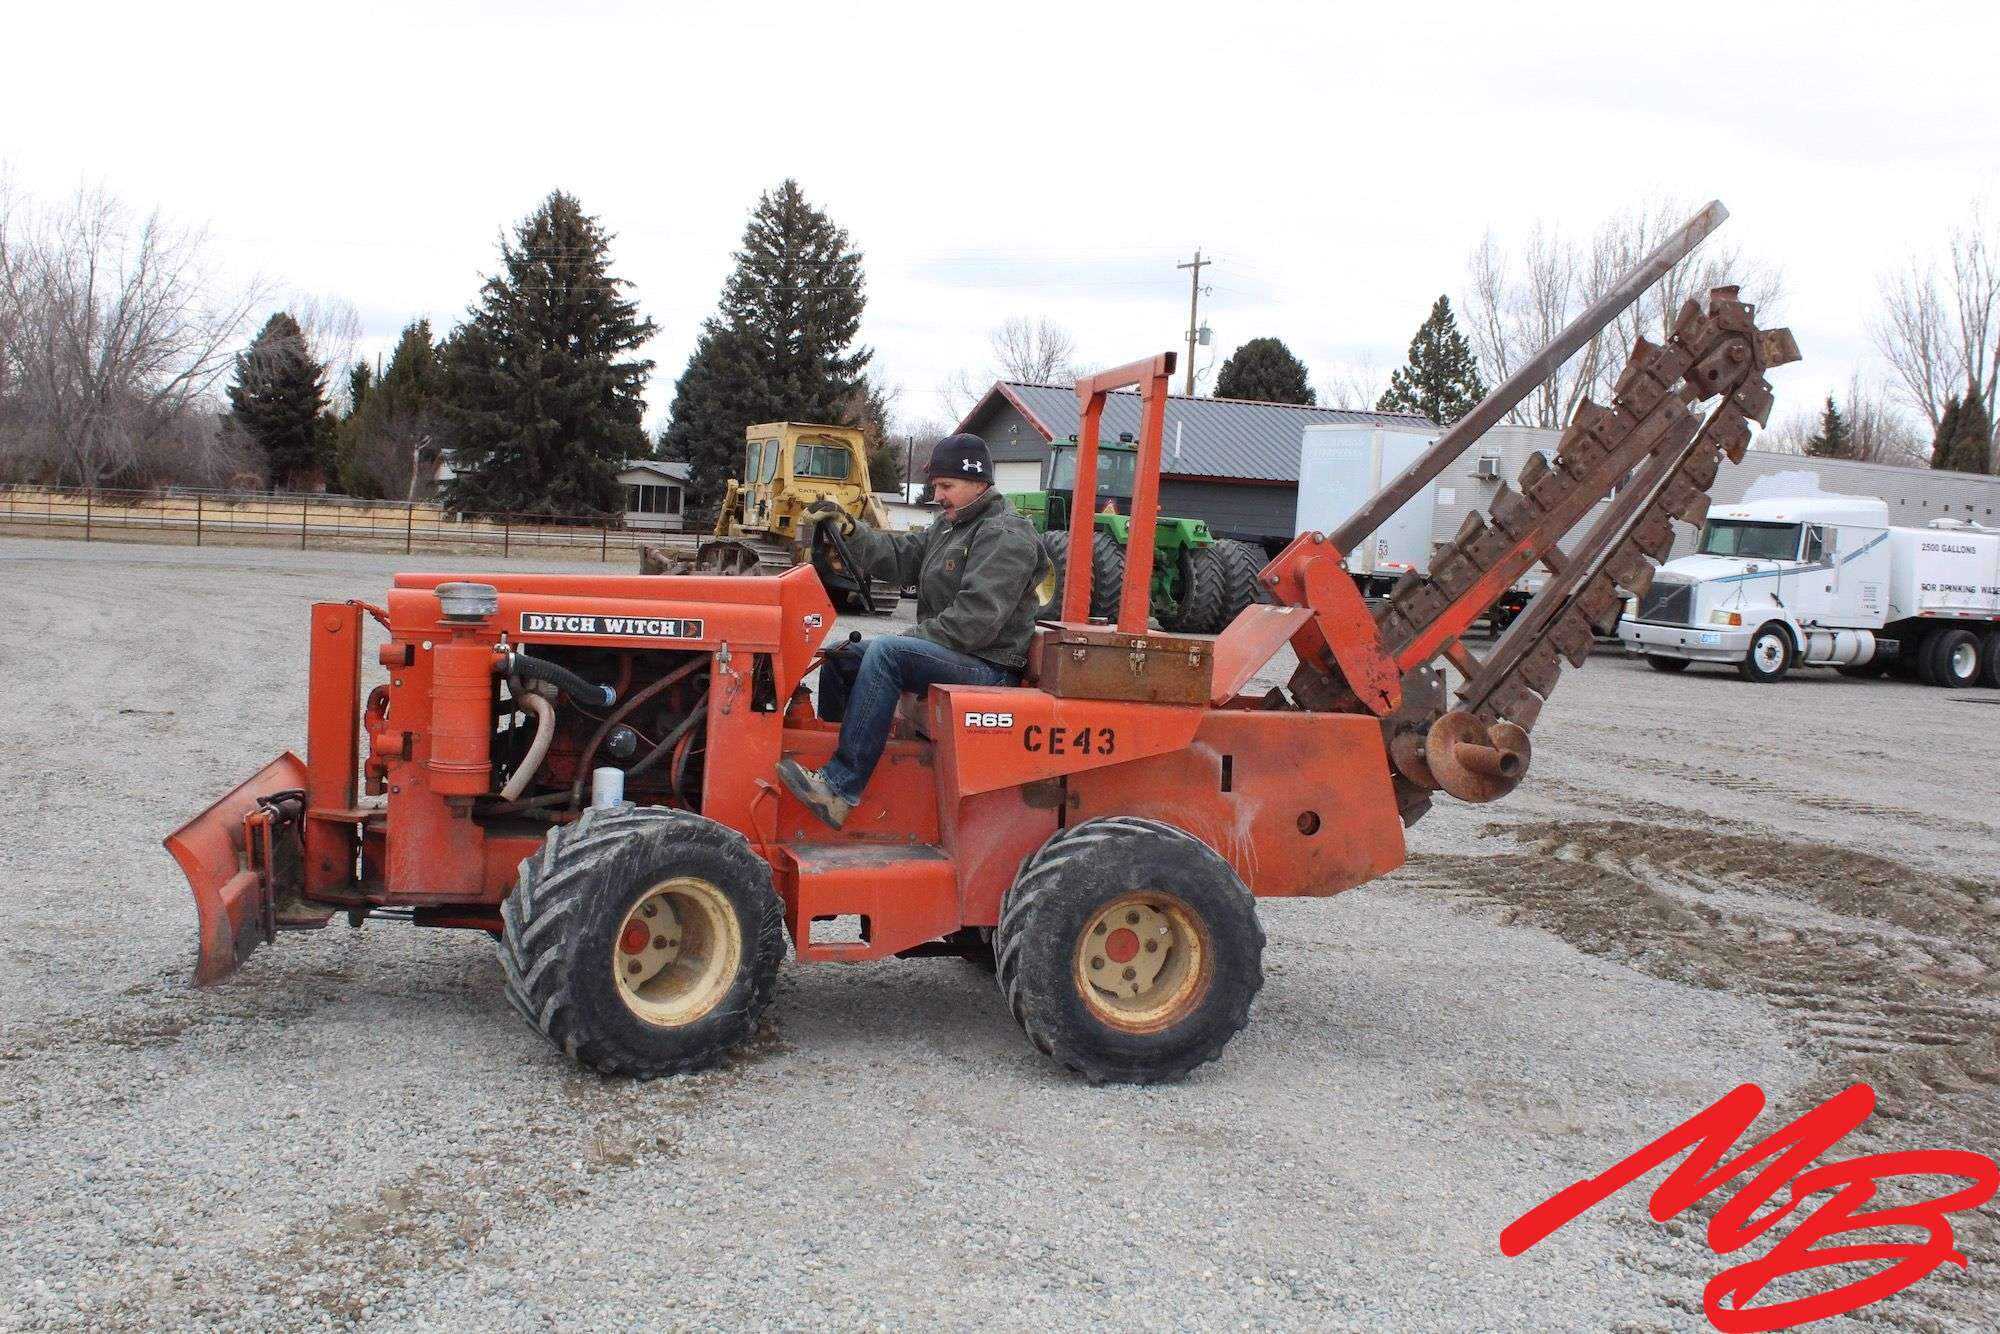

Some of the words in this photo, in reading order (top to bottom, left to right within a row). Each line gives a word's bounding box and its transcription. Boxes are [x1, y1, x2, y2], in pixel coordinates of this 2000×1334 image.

[1921, 543, 1939, 552] 2500
[1941, 544, 1976, 554] GALLONS
[1939, 584, 1976, 593] DRINKING
[529, 614, 596, 633] DITCH
[605, 617, 675, 636] WITCH
[964, 712, 1013, 728] R65
